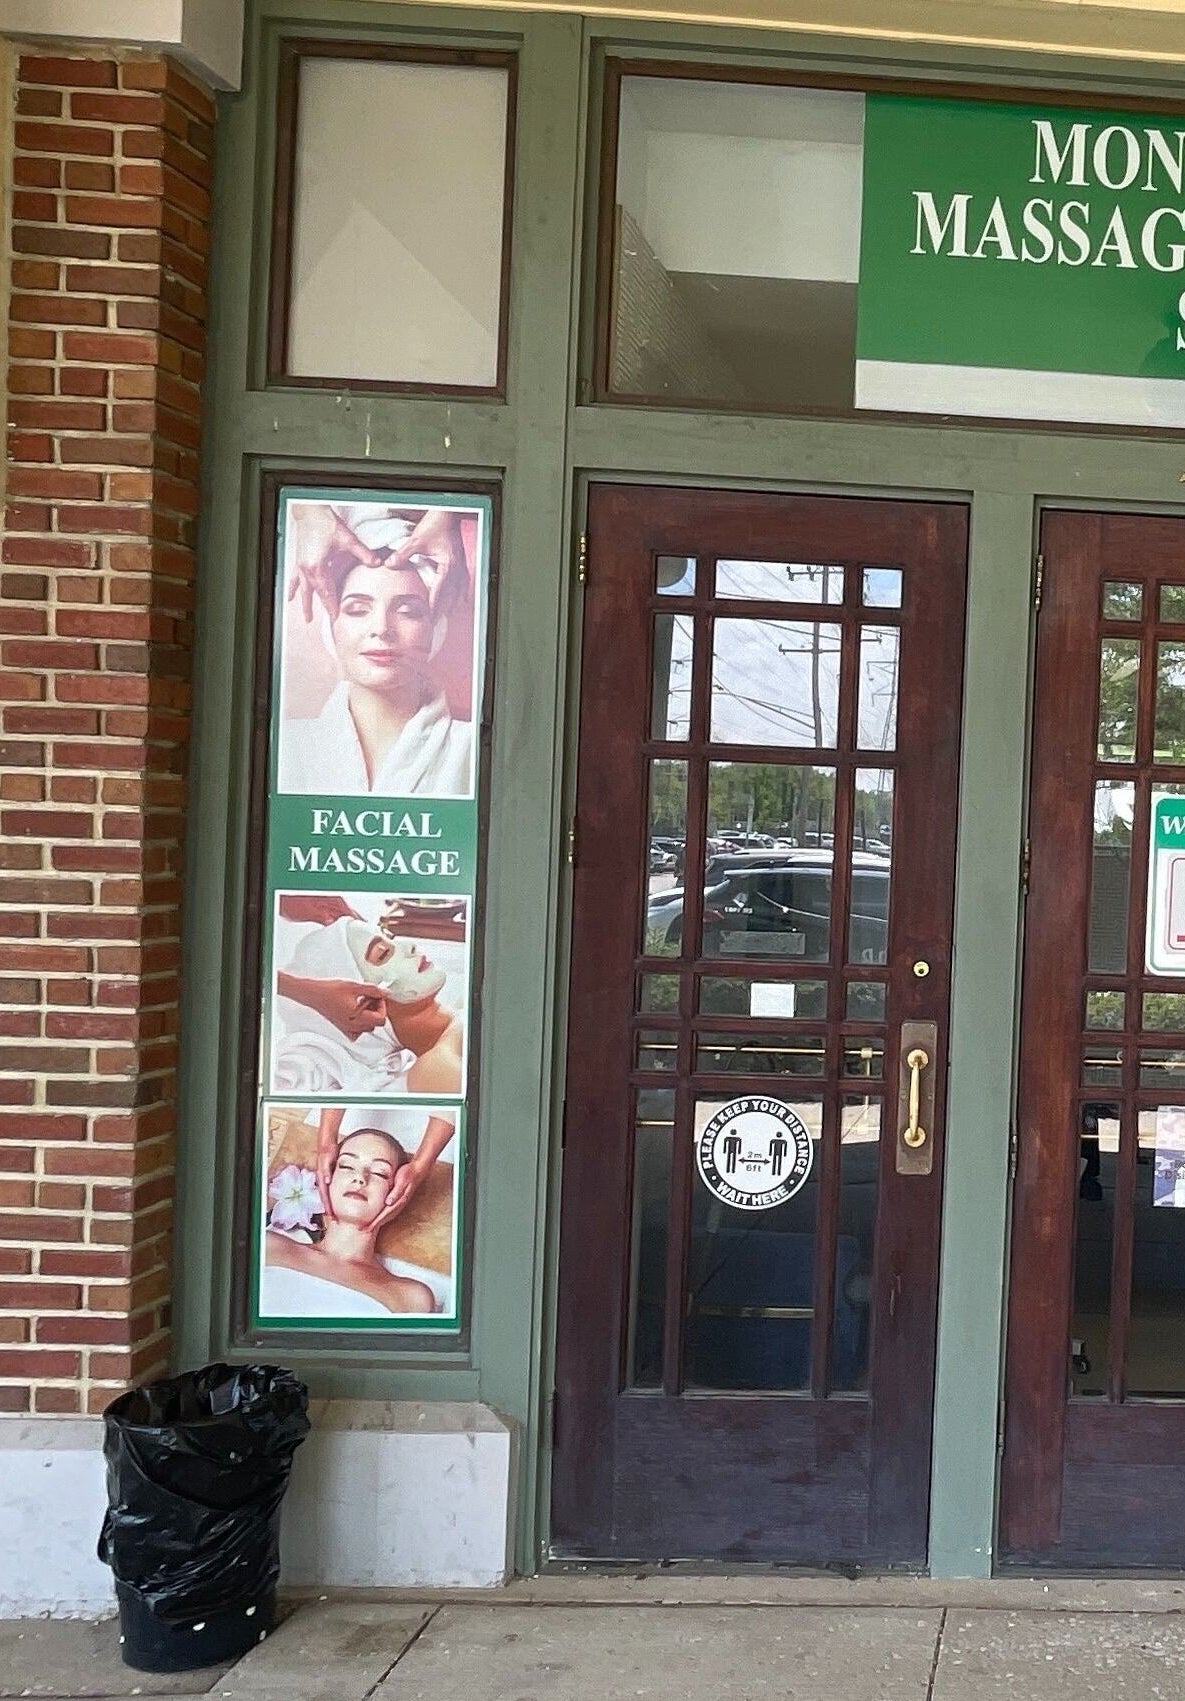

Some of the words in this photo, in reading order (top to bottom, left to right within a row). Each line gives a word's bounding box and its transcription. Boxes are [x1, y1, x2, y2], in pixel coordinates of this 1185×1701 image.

[311, 808, 443, 839] FACIAL
[288, 846, 460, 877] MASSAGE
[701, 1121, 721, 1170] PLEASE
[716, 1101, 749, 1124] KEEP
[751, 1100, 789, 1118] YOUR
[784, 1114, 809, 1175] DISTANCE
[716, 1181, 752, 1206] WAIT
[752, 1184, 789, 1206] HERE
